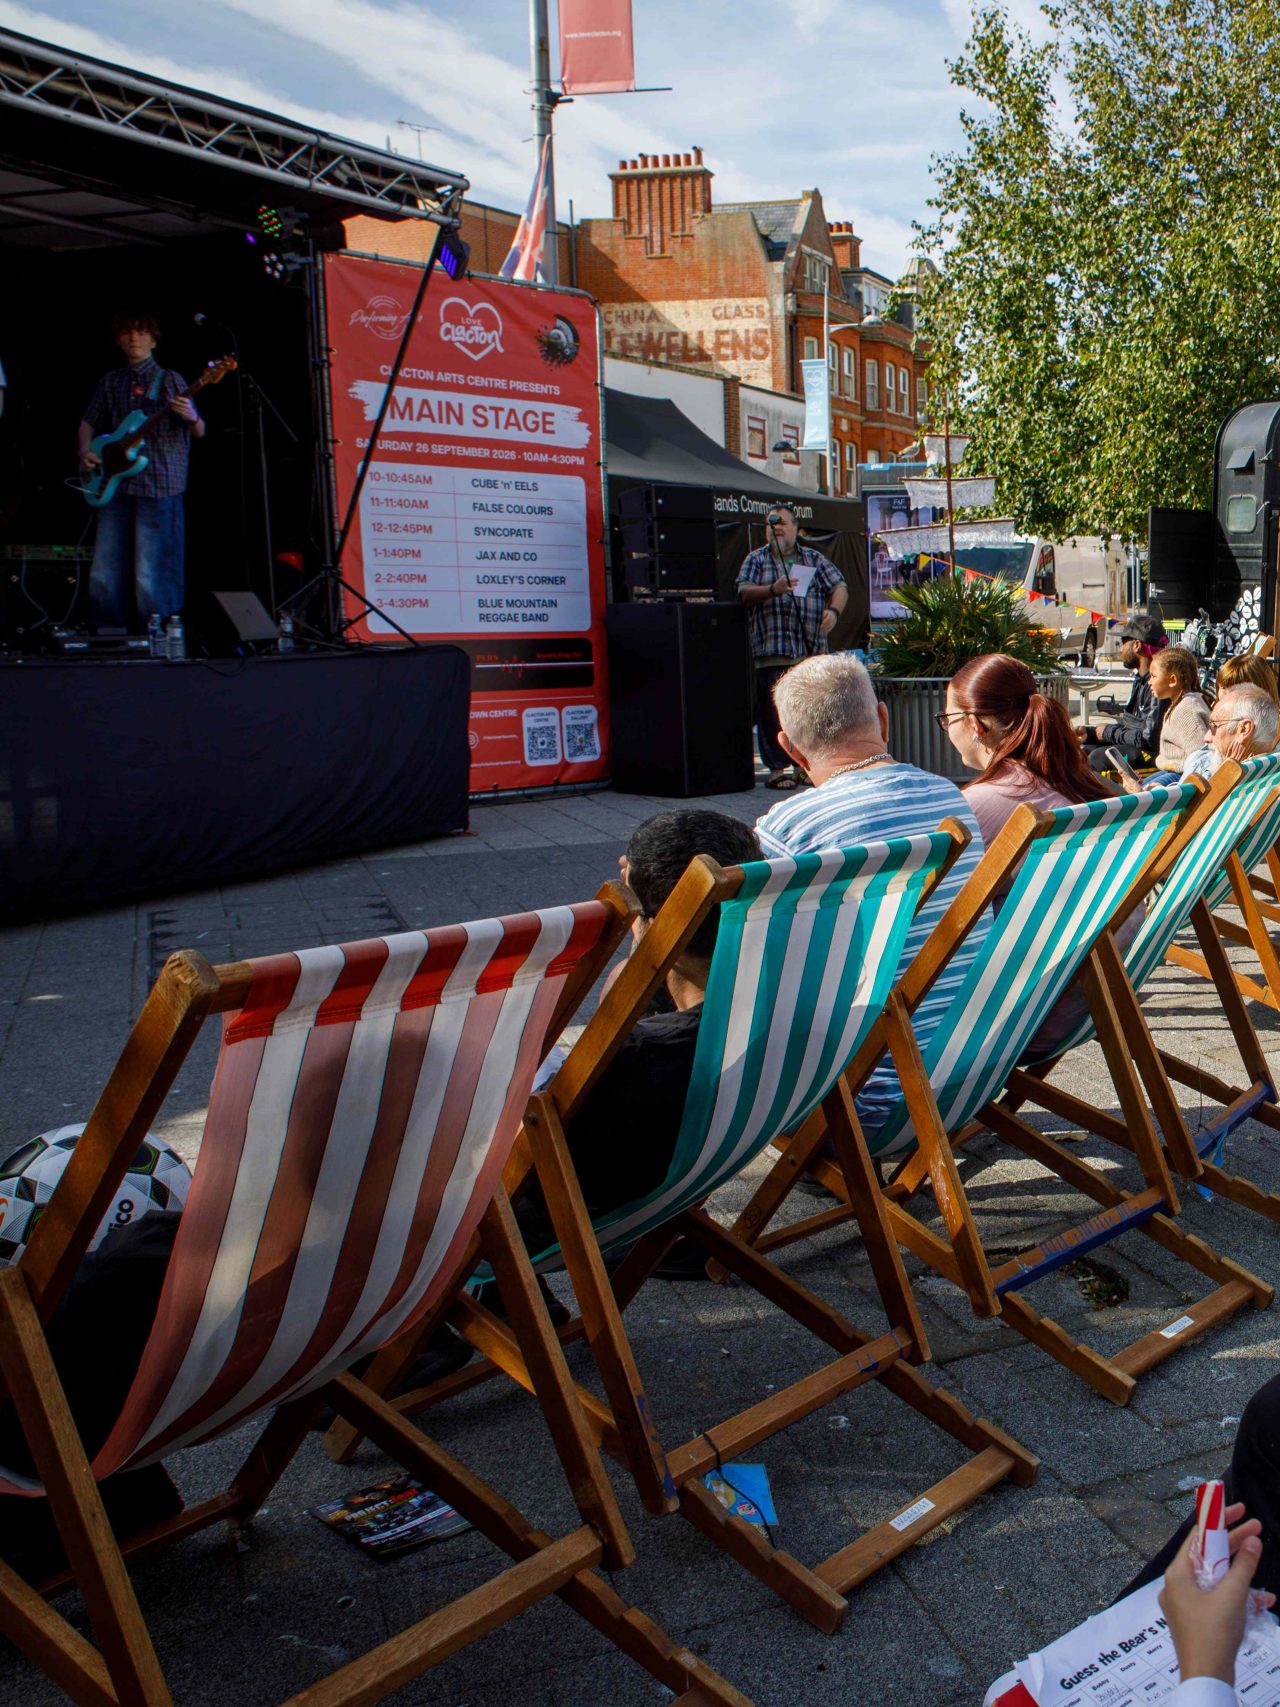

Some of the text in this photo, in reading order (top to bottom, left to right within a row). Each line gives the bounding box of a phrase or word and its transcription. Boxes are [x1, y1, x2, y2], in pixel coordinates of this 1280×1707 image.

[712, 304, 765, 321] GLASS
[461, 316, 481, 327] LOVE
[437, 371, 465, 385] ARTS
[467, 375, 507, 390] CENTRE
[509, 381, 561, 396] PRESENTS
[389, 395, 556, 435] MAIN STAGE
[356, 437, 585, 466] SAURDAY 26 SEPTEMBER 2026 10AM-4:30PM
[369, 471, 433, 485] 10-10:45AM
[471, 478, 499, 489] CUBE
[514, 481, 539, 492] EELS
[370, 496, 429, 509] 11-11:40AM
[472, 502, 553, 516] FALSE COLOURS
[371, 522, 433, 534] 12-12:45PM
[474, 526, 534, 538] SYNCOPATE
[373, 548, 422, 559] 1-1:40PM
[475, 551, 538, 561] JAX AND CO
[375, 573, 427, 583] 2-2:40PM
[476, 575, 566, 586] LOXLEY'S CORNER
[376, 598, 429, 609] 3-4:30PM
[478, 599, 558, 609] BLUE MOUNTAIN
[479, 613, 549, 622] REGGAE BAND
[469, 709, 518, 719] OWN CENTRE
[1060, 1625, 1159, 1690] Guess the Bear's
